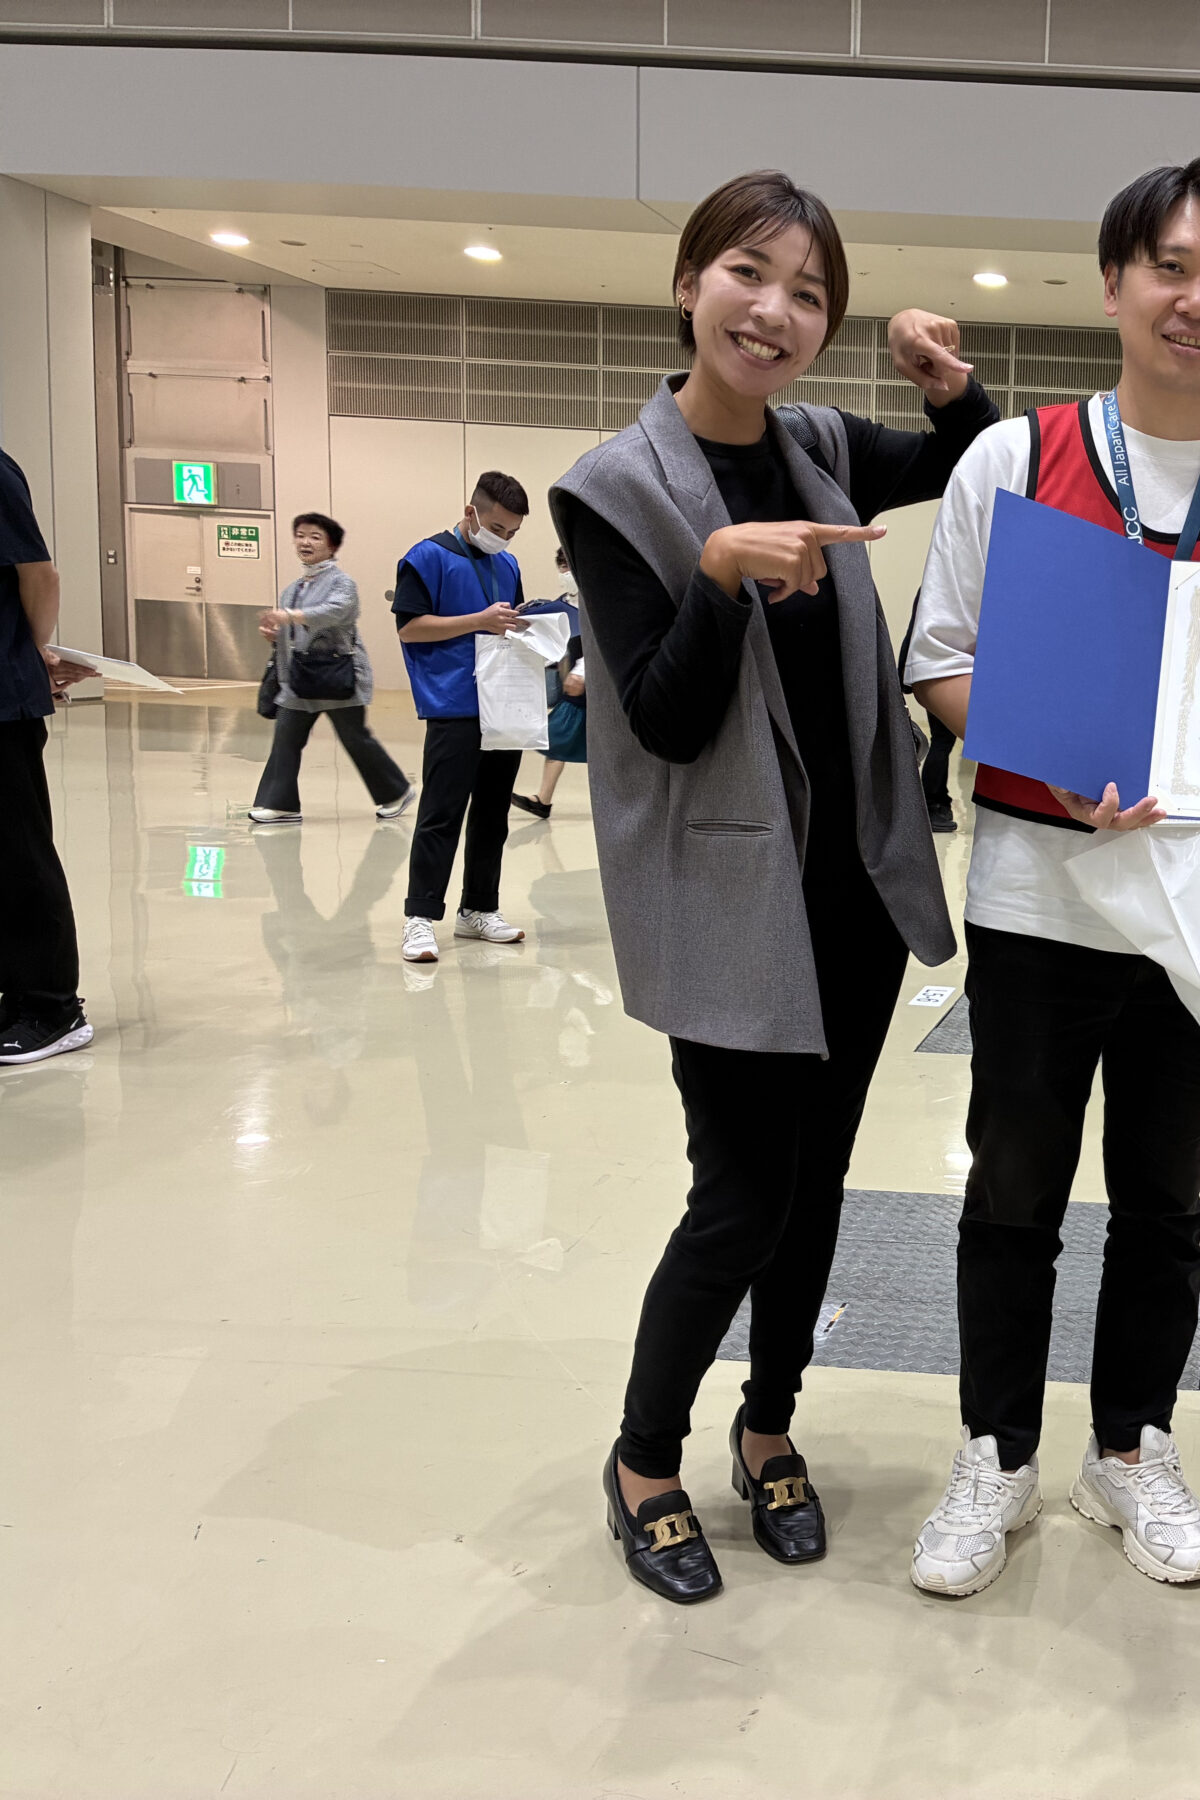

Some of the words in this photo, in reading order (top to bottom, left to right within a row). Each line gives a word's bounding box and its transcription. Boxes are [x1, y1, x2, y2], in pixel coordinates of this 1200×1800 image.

[1107, 404, 1120, 431] Care
[1111, 431, 1127, 467] Japan
[1115, 468, 1130, 486] All
[231, 528, 255, 536] 非常口
[1123, 506, 1144, 545] JCC
